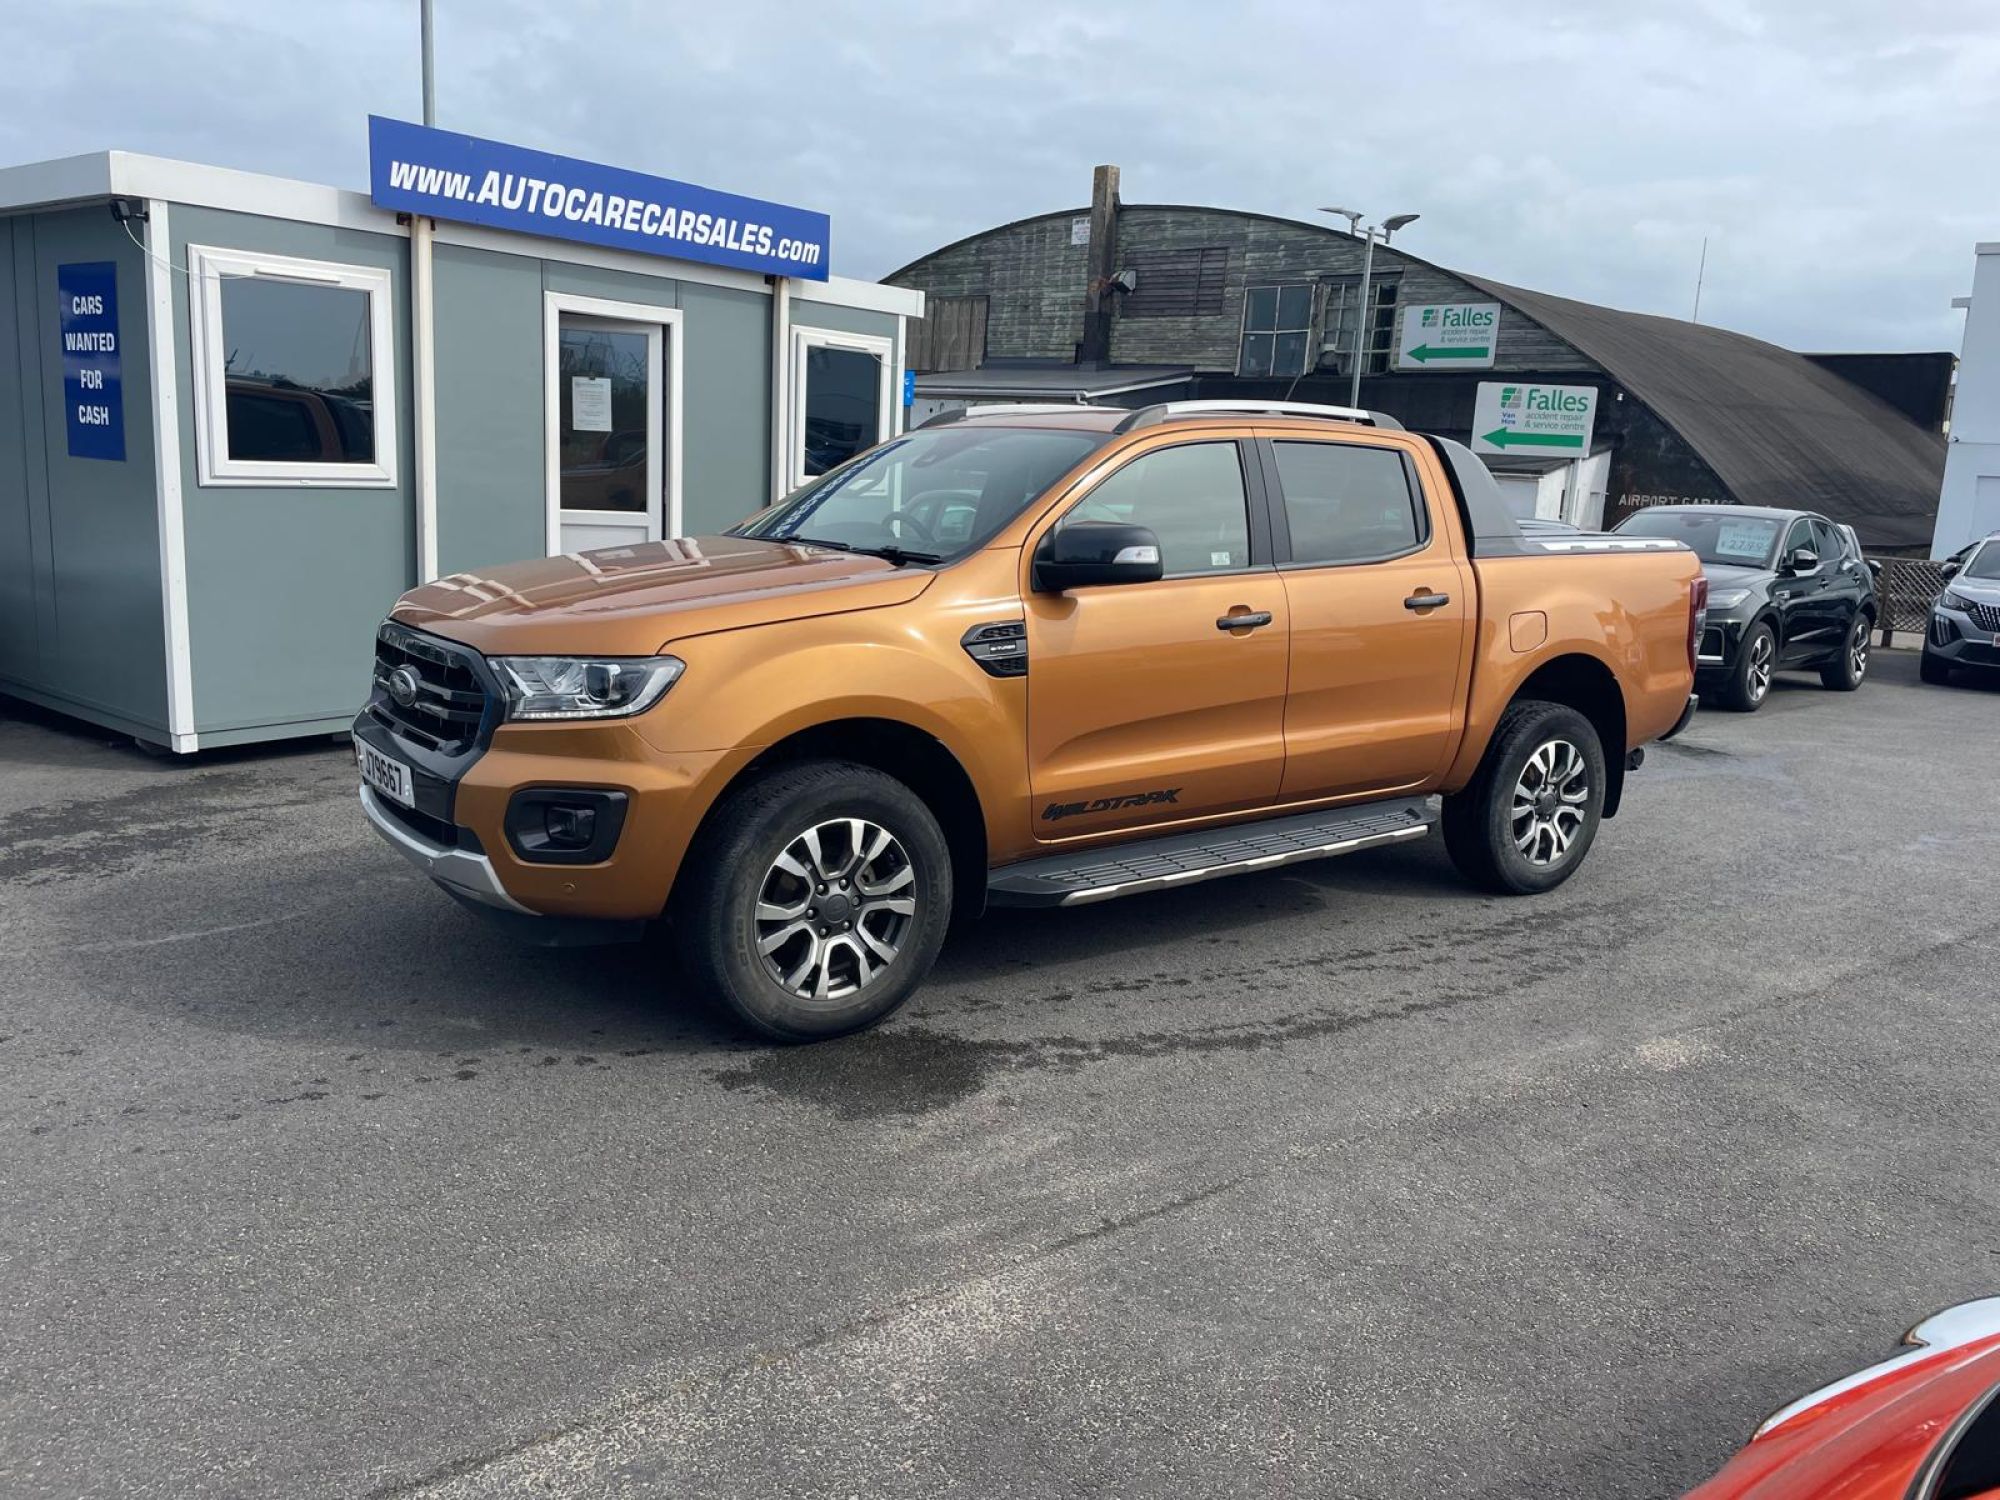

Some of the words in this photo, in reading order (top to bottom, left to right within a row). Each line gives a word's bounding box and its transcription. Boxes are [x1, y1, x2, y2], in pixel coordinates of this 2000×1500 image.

[388, 160, 821, 266] www.AUTOCARECARSALES.com
[72, 295, 104, 316] CARS
[1442, 307, 1494, 327] Falles
[65, 332, 116, 352] WANTED
[80, 369, 103, 390] FOR
[1526, 388, 1589, 412] Falles
[78, 404, 110, 426] CASH
[1502, 411, 1516, 419] Van
[1525, 411, 1558, 421] accident
[1560, 413, 1583, 422] repair
[1524, 420, 1531, 429] &
[1531, 420, 1558, 429] service
[1560, 422, 1585, 431] centre
[1618, 493, 1678, 506] AIRPORT
